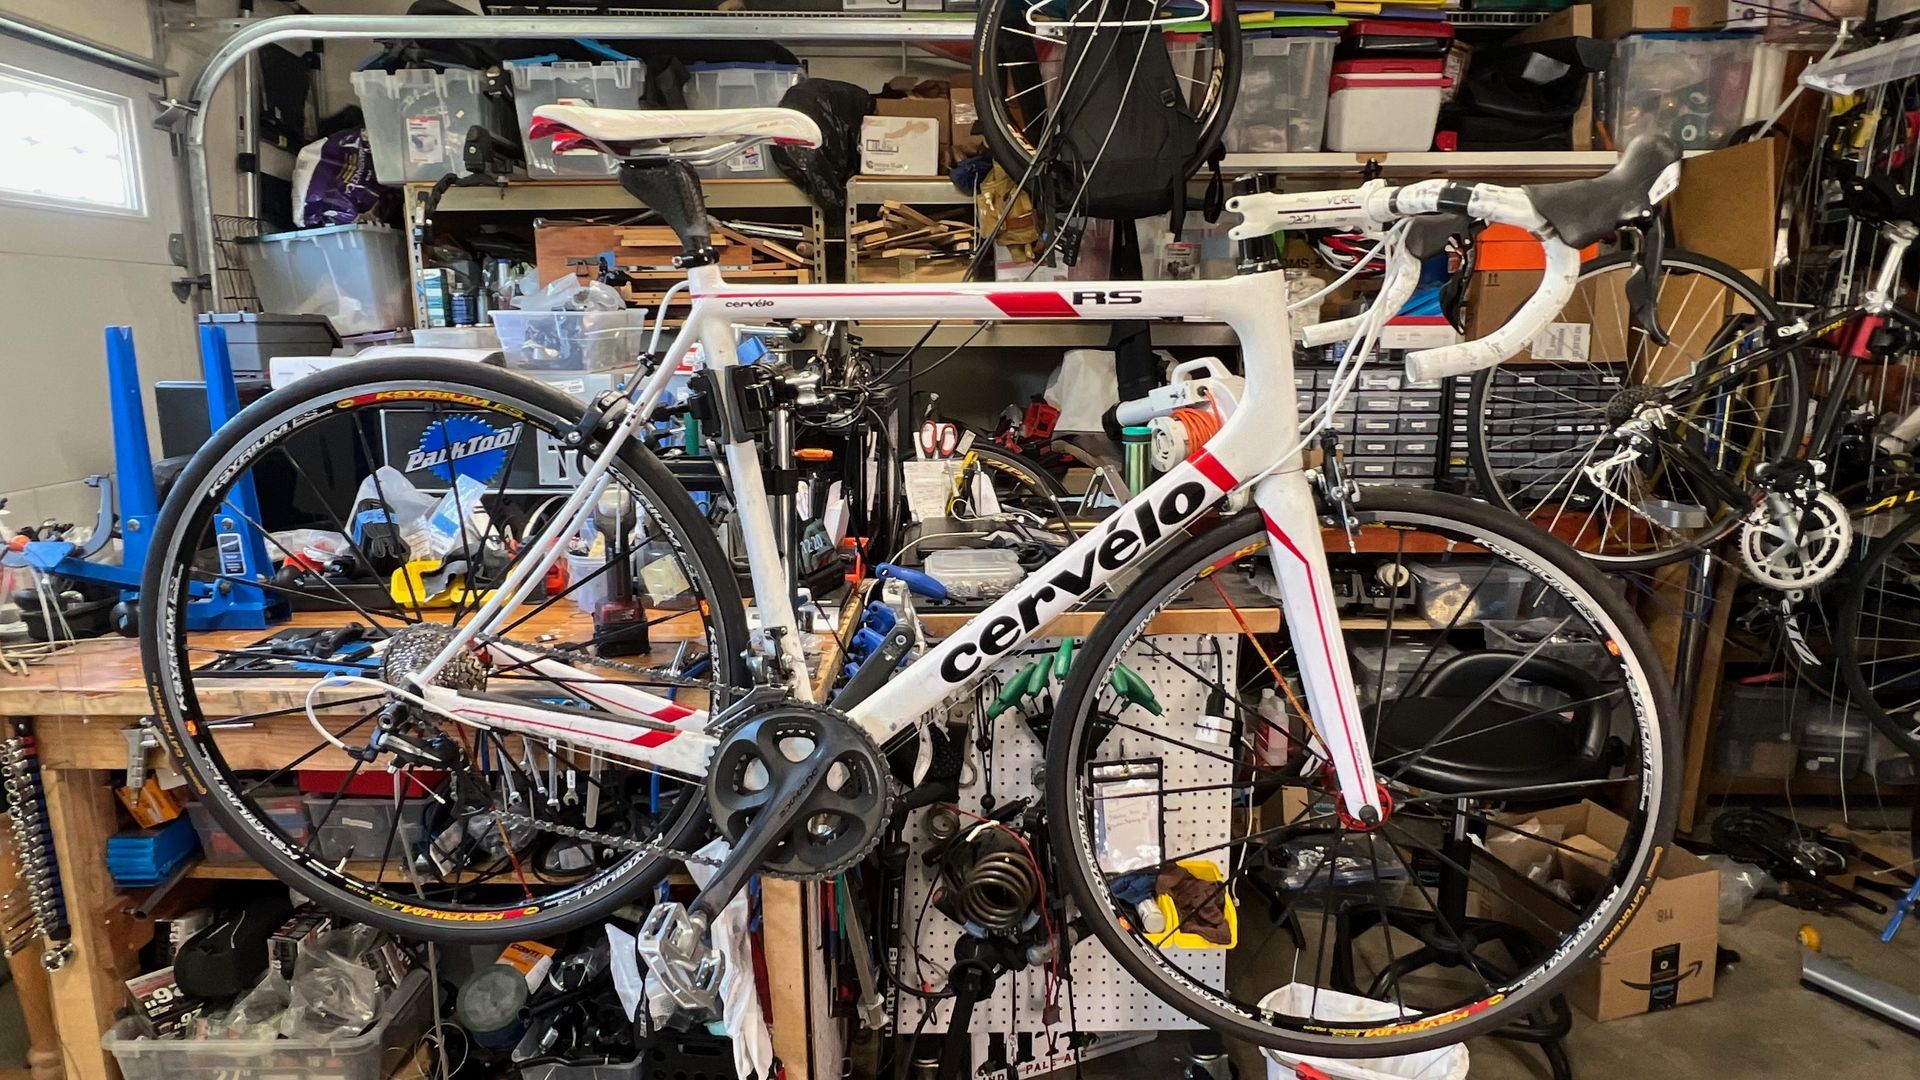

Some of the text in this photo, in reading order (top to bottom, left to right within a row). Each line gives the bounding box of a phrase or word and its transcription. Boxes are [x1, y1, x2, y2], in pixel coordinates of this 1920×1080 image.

[725, 299, 775, 309] cervélo
[1073, 290, 1142, 305] RS
[940, 481, 1206, 683] cervélo
